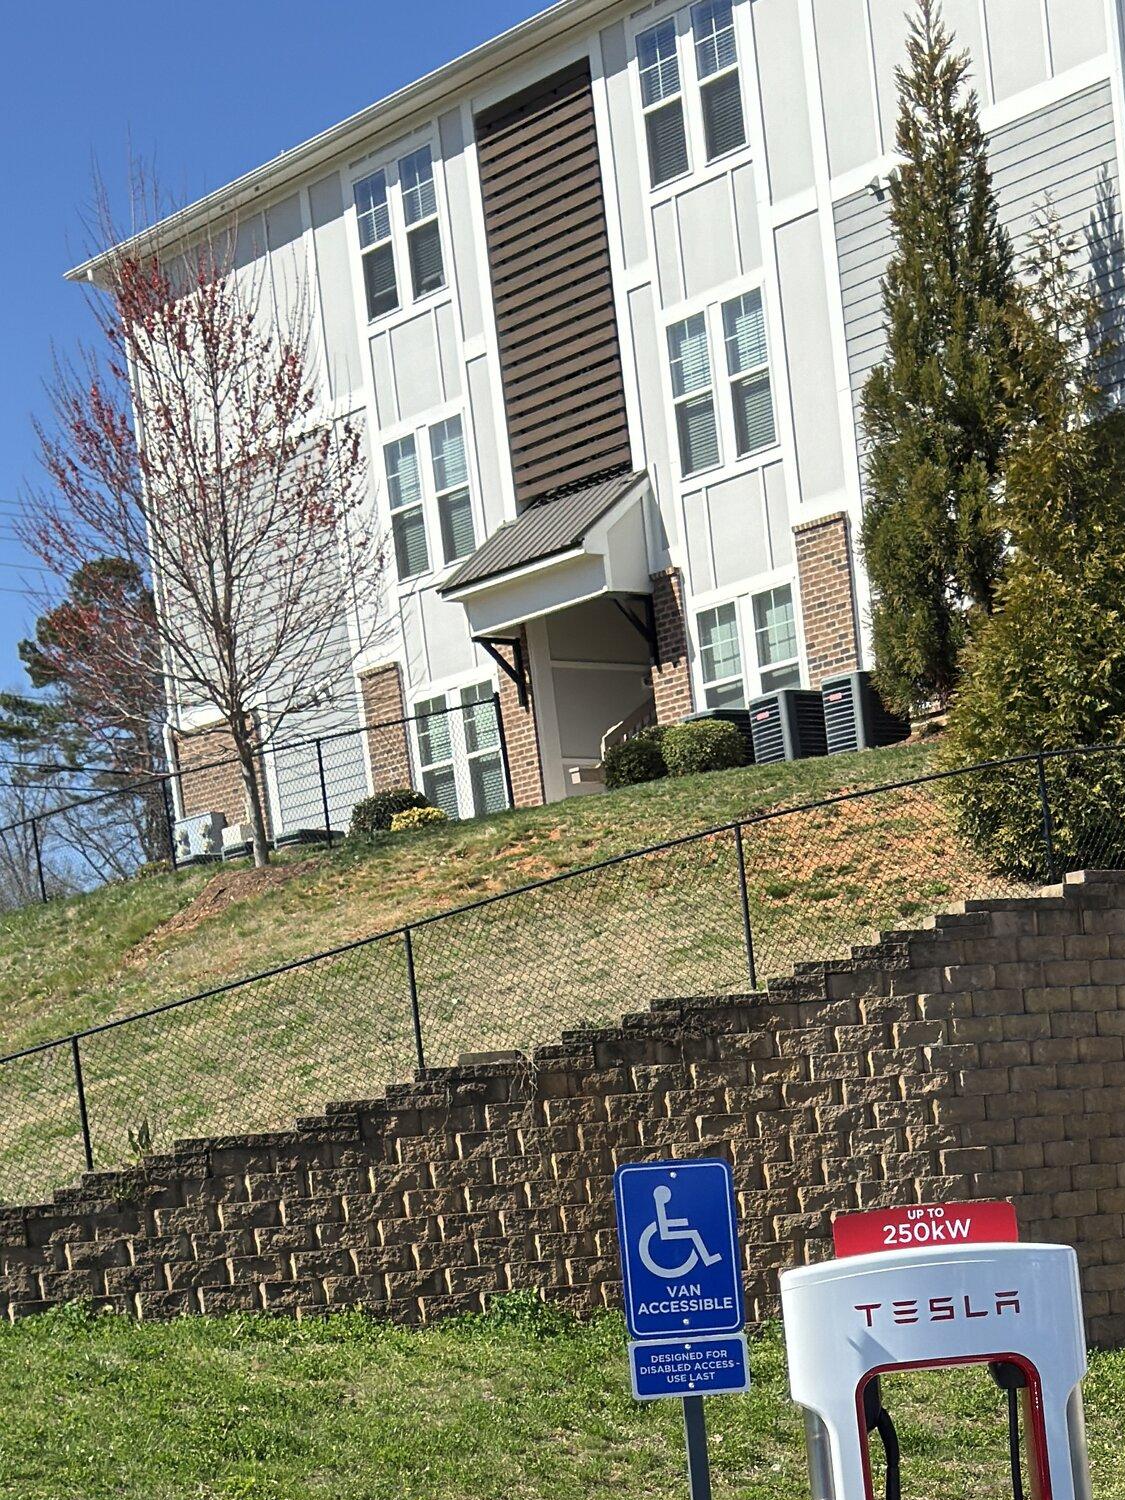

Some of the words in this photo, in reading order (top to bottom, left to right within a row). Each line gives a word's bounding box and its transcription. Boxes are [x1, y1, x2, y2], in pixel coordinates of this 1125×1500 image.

[907, 1209, 924, 1220] UP
[927, 1207, 945, 1218] TO
[883, 1218, 971, 1245] 250kW
[667, 1284, 701, 1298] VAN
[638, 1297, 733, 1315] ACCESSIBLE
[854, 1290, 1021, 1327] TESLA
[651, 1352, 704, 1364] DESIGNED
[706, 1350, 728, 1360] FOR
[640, 1363, 691, 1375] DISABLED
[667, 1374, 687, 1384] USE
[689, 1371, 716, 1382] LAST
